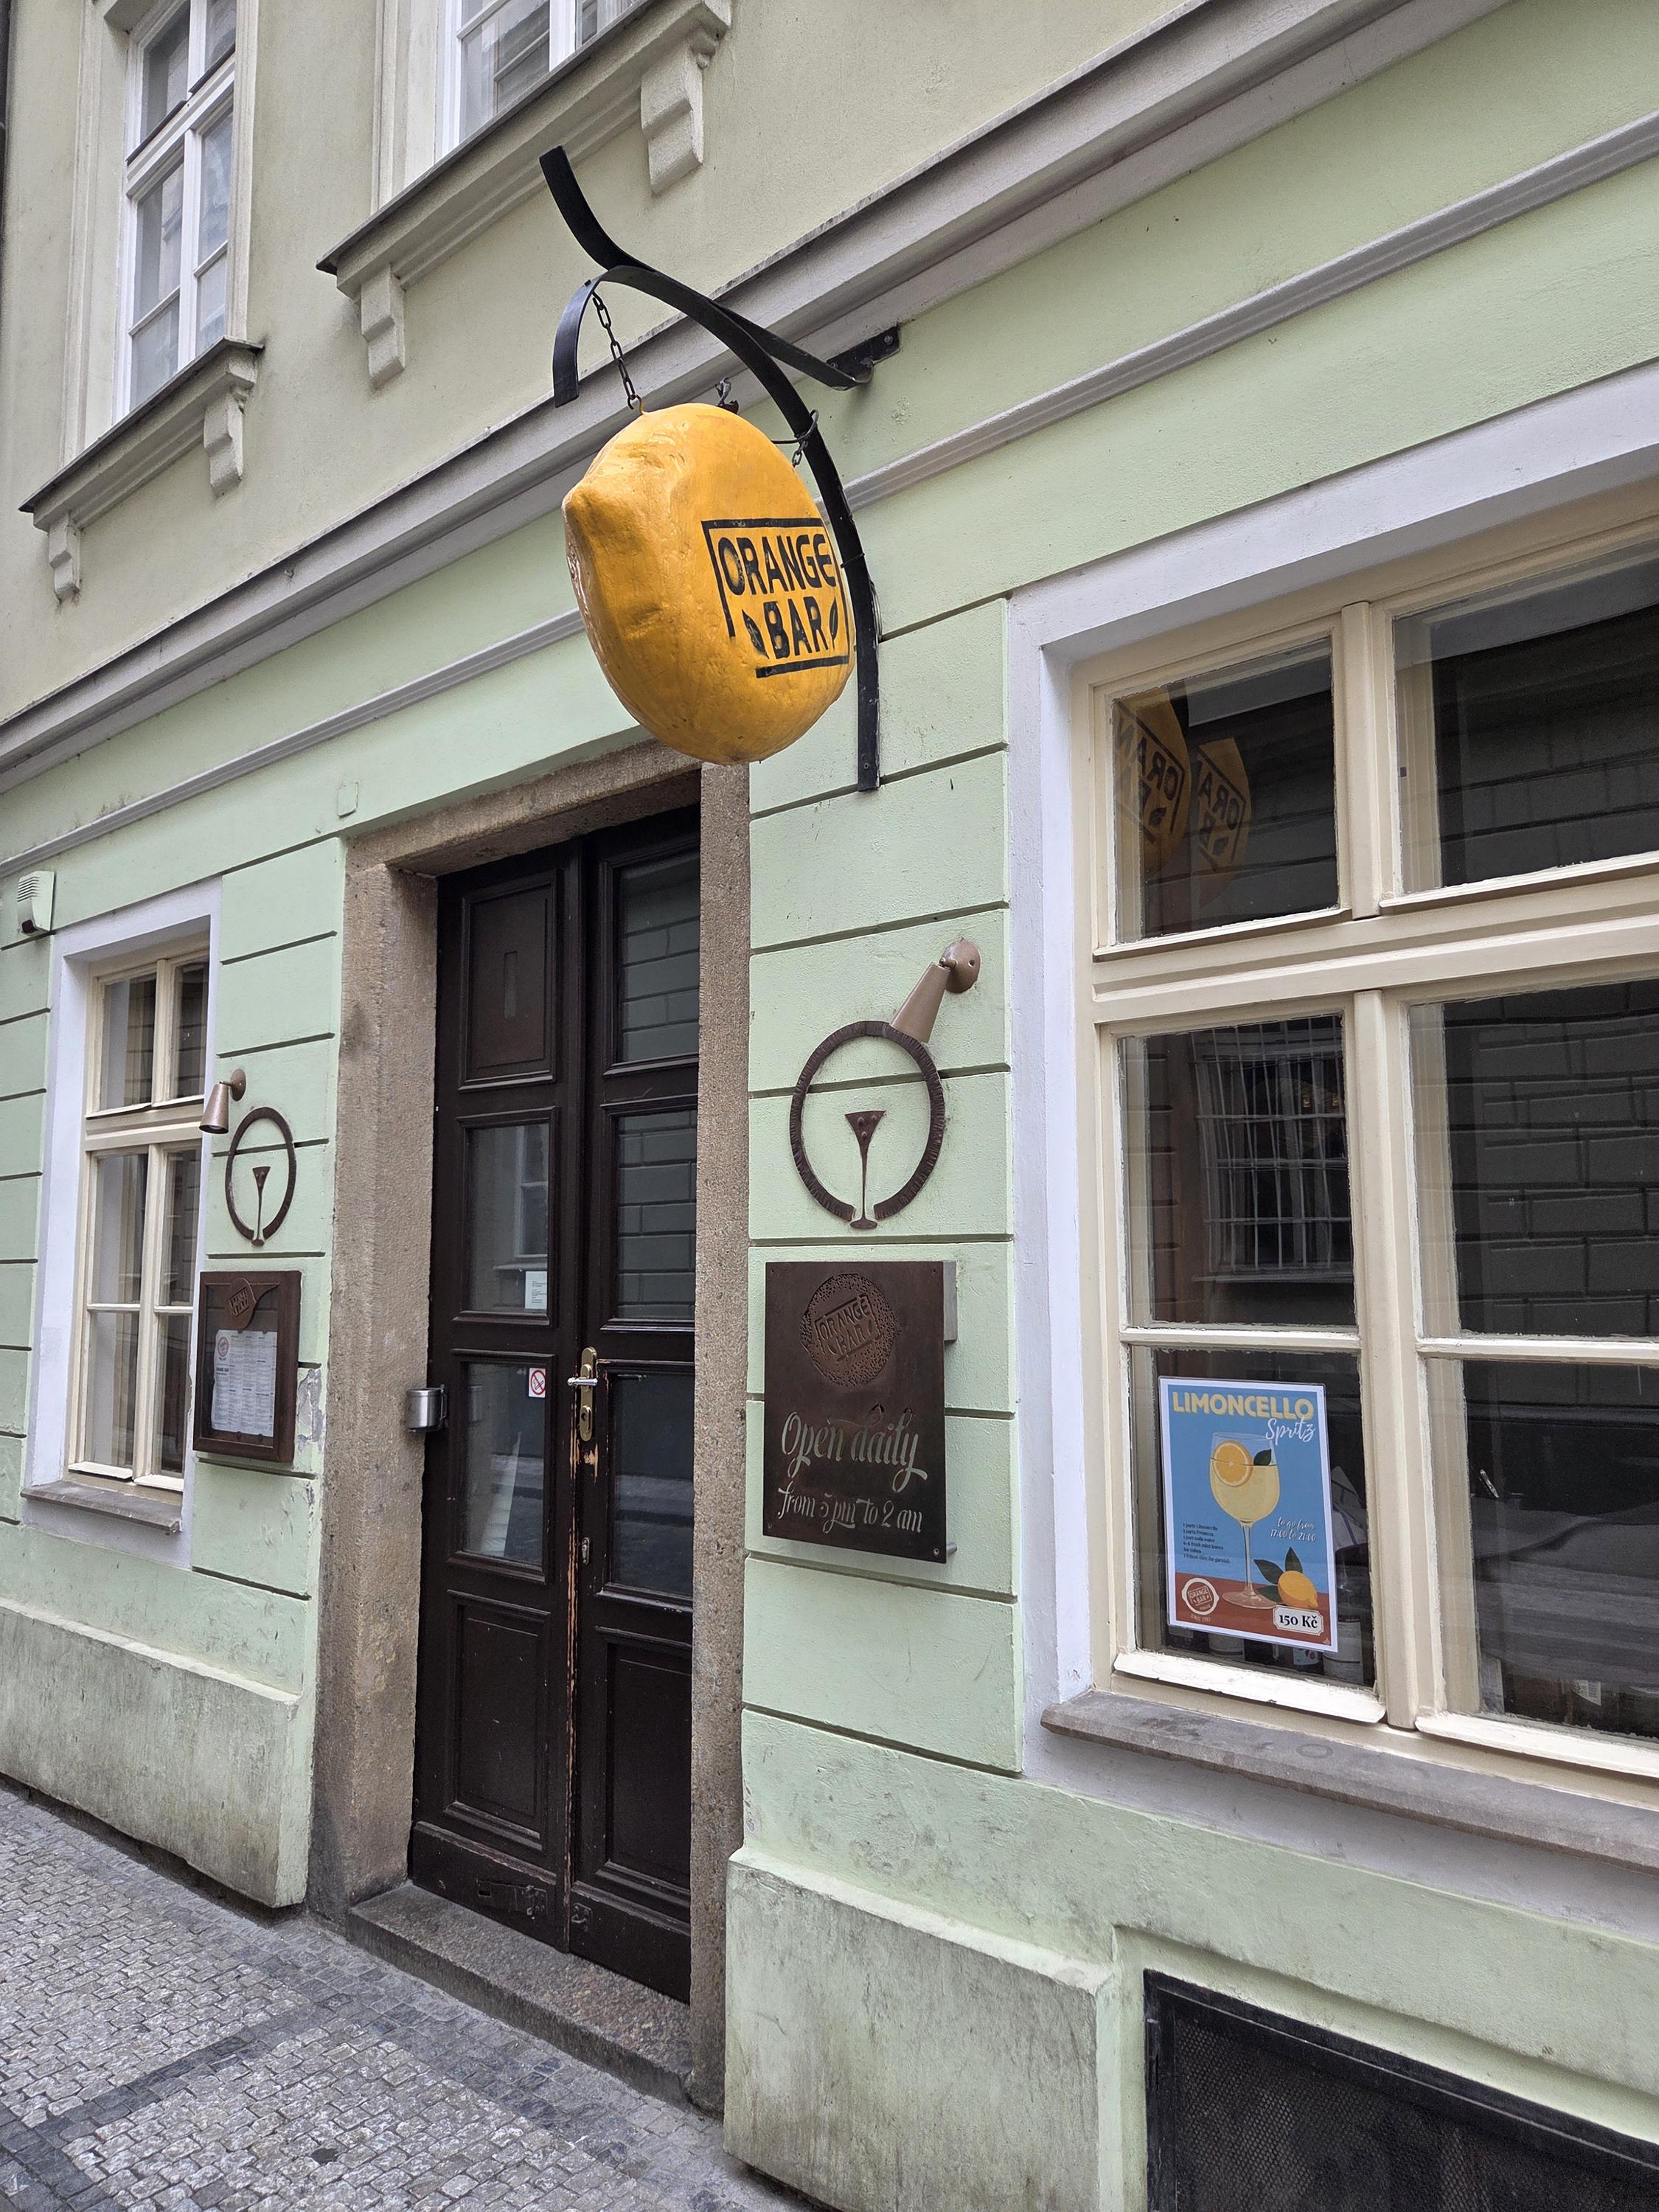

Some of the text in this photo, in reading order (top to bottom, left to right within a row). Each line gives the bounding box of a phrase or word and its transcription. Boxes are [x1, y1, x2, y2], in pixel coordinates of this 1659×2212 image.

[718, 533, 836, 596] ORANGE
[763, 597, 829, 659] BAR
[818, 1298, 870, 1340] ORANGE
[835, 1324, 866, 1357] BAR
[1172, 1391, 1314, 1420] LIMONCELLO
[782, 1404, 928, 1493] Open daily
[1265, 1416, 1316, 1446] Spritz
[777, 1481, 922, 1534] from 5 pm to 2 am
[1279, 1615, 1318, 1628] 150 Kč
